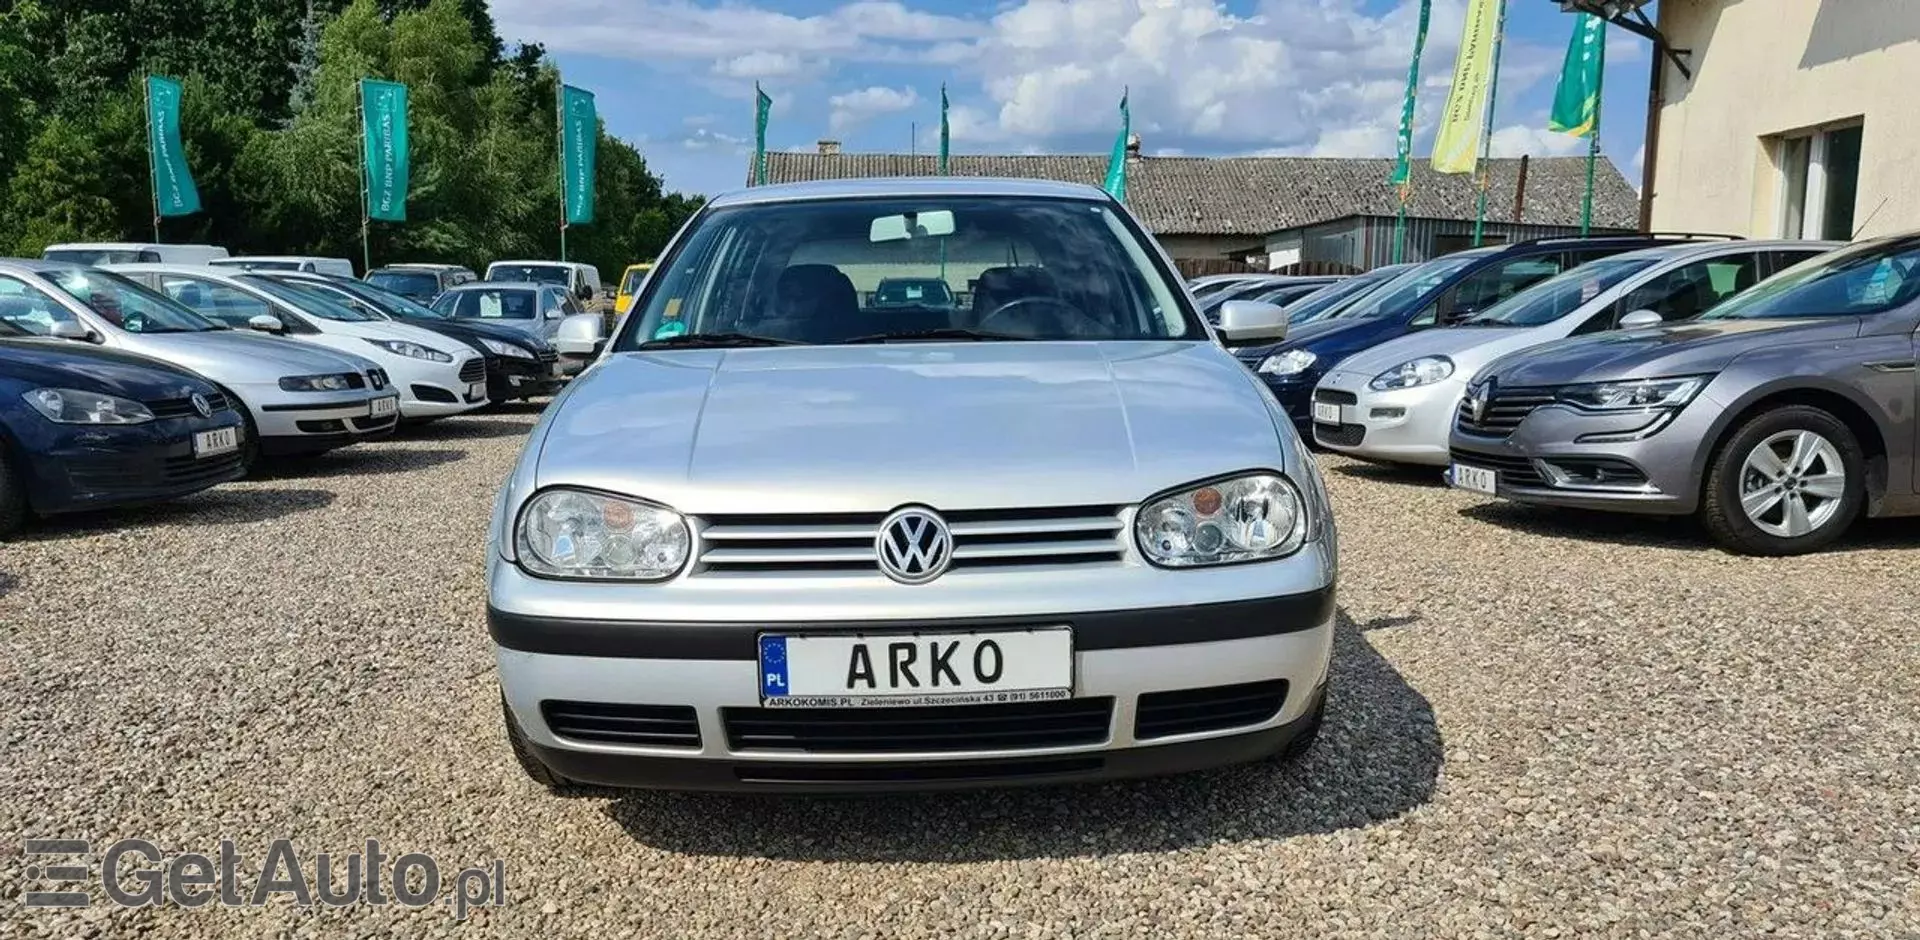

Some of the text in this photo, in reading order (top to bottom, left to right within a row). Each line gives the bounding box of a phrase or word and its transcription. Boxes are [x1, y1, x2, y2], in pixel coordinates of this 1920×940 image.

[382, 113, 393, 162] PARIBAS
[384, 163, 393, 188] BNP
[206, 430, 230, 450] ARKO
[1458, 467, 1488, 489] ARKO
[847, 638, 1004, 689] ARKO
[766, 673, 786, 687] PL
[983, 694, 994, 702] 43
[1010, 692, 1026, 701] (91)
